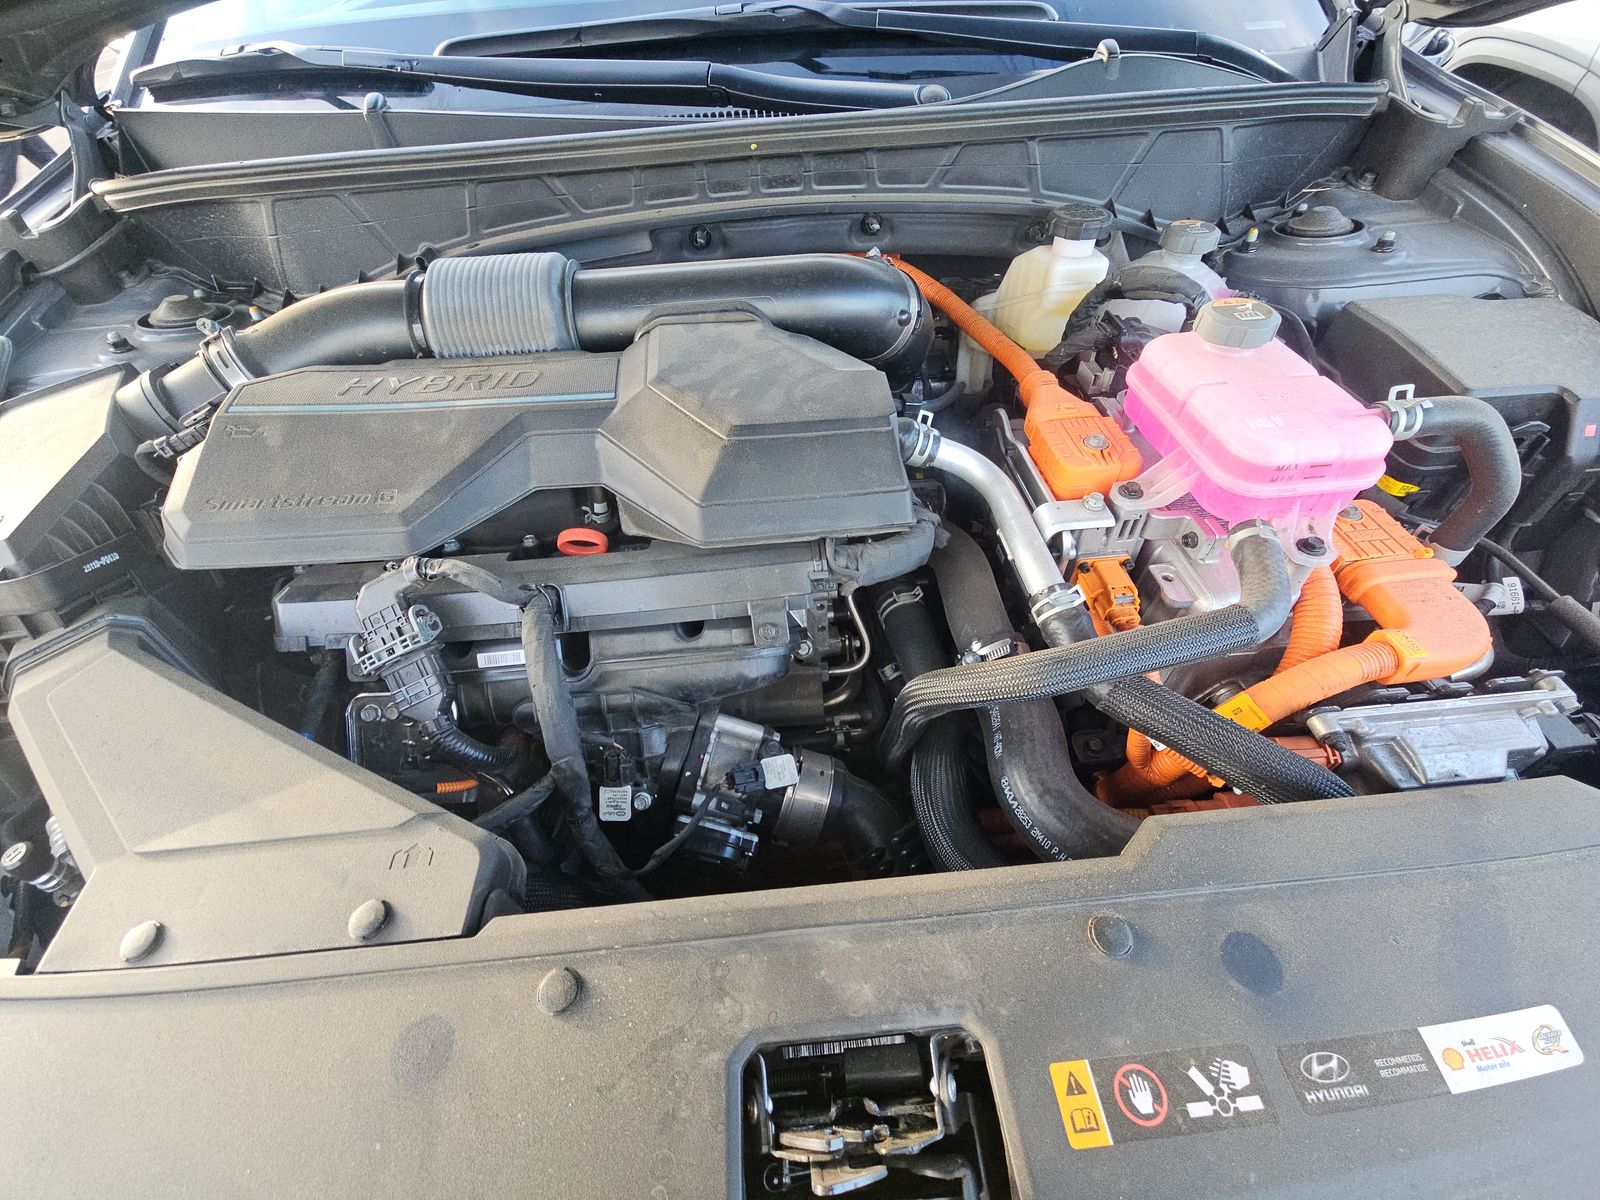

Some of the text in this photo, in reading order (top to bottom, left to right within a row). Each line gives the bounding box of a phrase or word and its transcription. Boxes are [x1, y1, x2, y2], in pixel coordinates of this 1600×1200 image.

[336, 371, 541, 397] HYBRID
[1275, 463, 1299, 472] MAX
[1269, 475, 1294, 483] MIN
[200, 493, 372, 511] Smartstream
[1014, 805, 1033, 829] 28253
[1030, 826, 1052, 849] 2M410
[1051, 846, 1073, 862] P.H
[1461, 1038, 1475, 1047] Shell
[1466, 1041, 1522, 1063] HELIX
[1374, 1053, 1423, 1067] RECOMMENDS
[1476, 1060, 1511, 1073] Motor oils
[1379, 1063, 1429, 1078] RECOMMANDE
[1303, 1084, 1370, 1103] HYUNDAI
